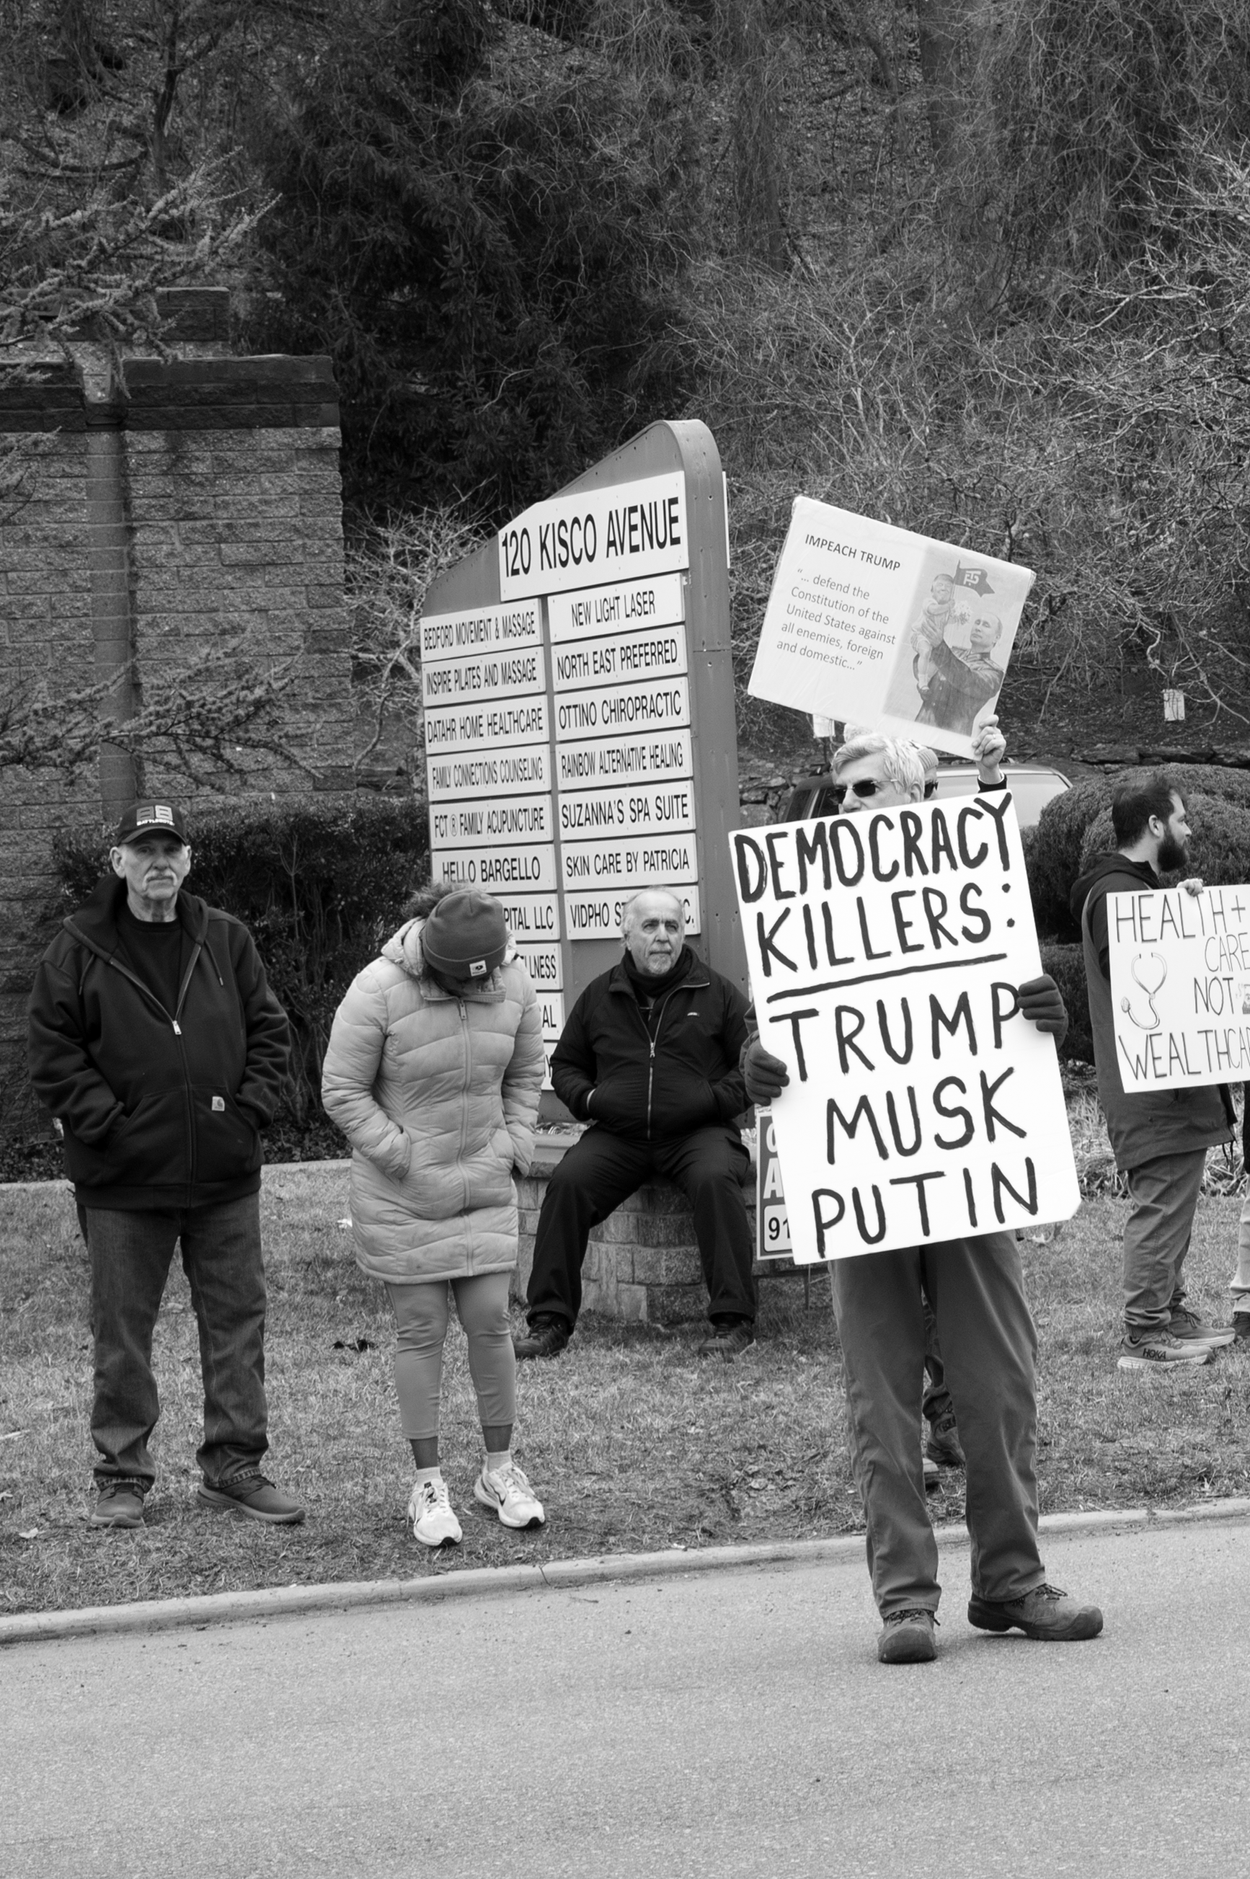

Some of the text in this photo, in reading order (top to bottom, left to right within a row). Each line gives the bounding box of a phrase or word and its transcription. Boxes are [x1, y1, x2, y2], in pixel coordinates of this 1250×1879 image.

[502, 497, 681, 577] 120 KISCO AVENUE
[805, 534, 901, 571] IMPEACH TRUMP
[791, 586, 889, 625] Constitution of the
[813, 574, 850, 594] defend
[853, 587, 870, 600] the
[571, 590, 655, 627] NEW LIGHT LASER
[786, 604, 896, 645] United States against
[424, 611, 535, 650] BEDFORD MOVEMENT & MASSAGE
[777, 640, 797, 653] and
[781, 622, 884, 660] all enemies, foreign
[426, 658, 536, 695] INSPIRE PILATES AND MASSAGE
[557, 639, 677, 680] NORTH EAST PREFERRED
[427, 708, 543, 743] DATAHR HOME HEALTHCARE
[559, 690, 681, 730] OTTINO CHIROPRACTIC
[432, 757, 543, 790] FAMILY CONNECTIONS COUNSELING
[561, 741, 683, 779] RAINBOW ALTERNATIVE HEALING
[434, 815, 448, 838] FCT
[460, 811, 484, 836] FAMILY
[487, 807, 544, 834] ACUPUNCTURE
[561, 794, 688, 829] SUZANNA'S SPA SUITE
[566, 848, 690, 878] SKIN CARE BY PATRICIA
[734, 792, 1012, 903] DEMOCRACY
[442, 856, 541, 883] HELLO BARGELLO
[534, 905, 554, 930] LLC
[570, 902, 610, 928] VIDPHO
[757, 882, 1015, 977] KILLERS:
[1115, 890, 1227, 943] HEALTH
[1194, 976, 1234, 1016] NOT
[769, 982, 1022, 1082] TRUMP
[826, 1067, 1027, 1165] MUSK
[812, 1157, 1039, 1259] PUTIN
[1142, 1348, 1167, 1359] HOKA
